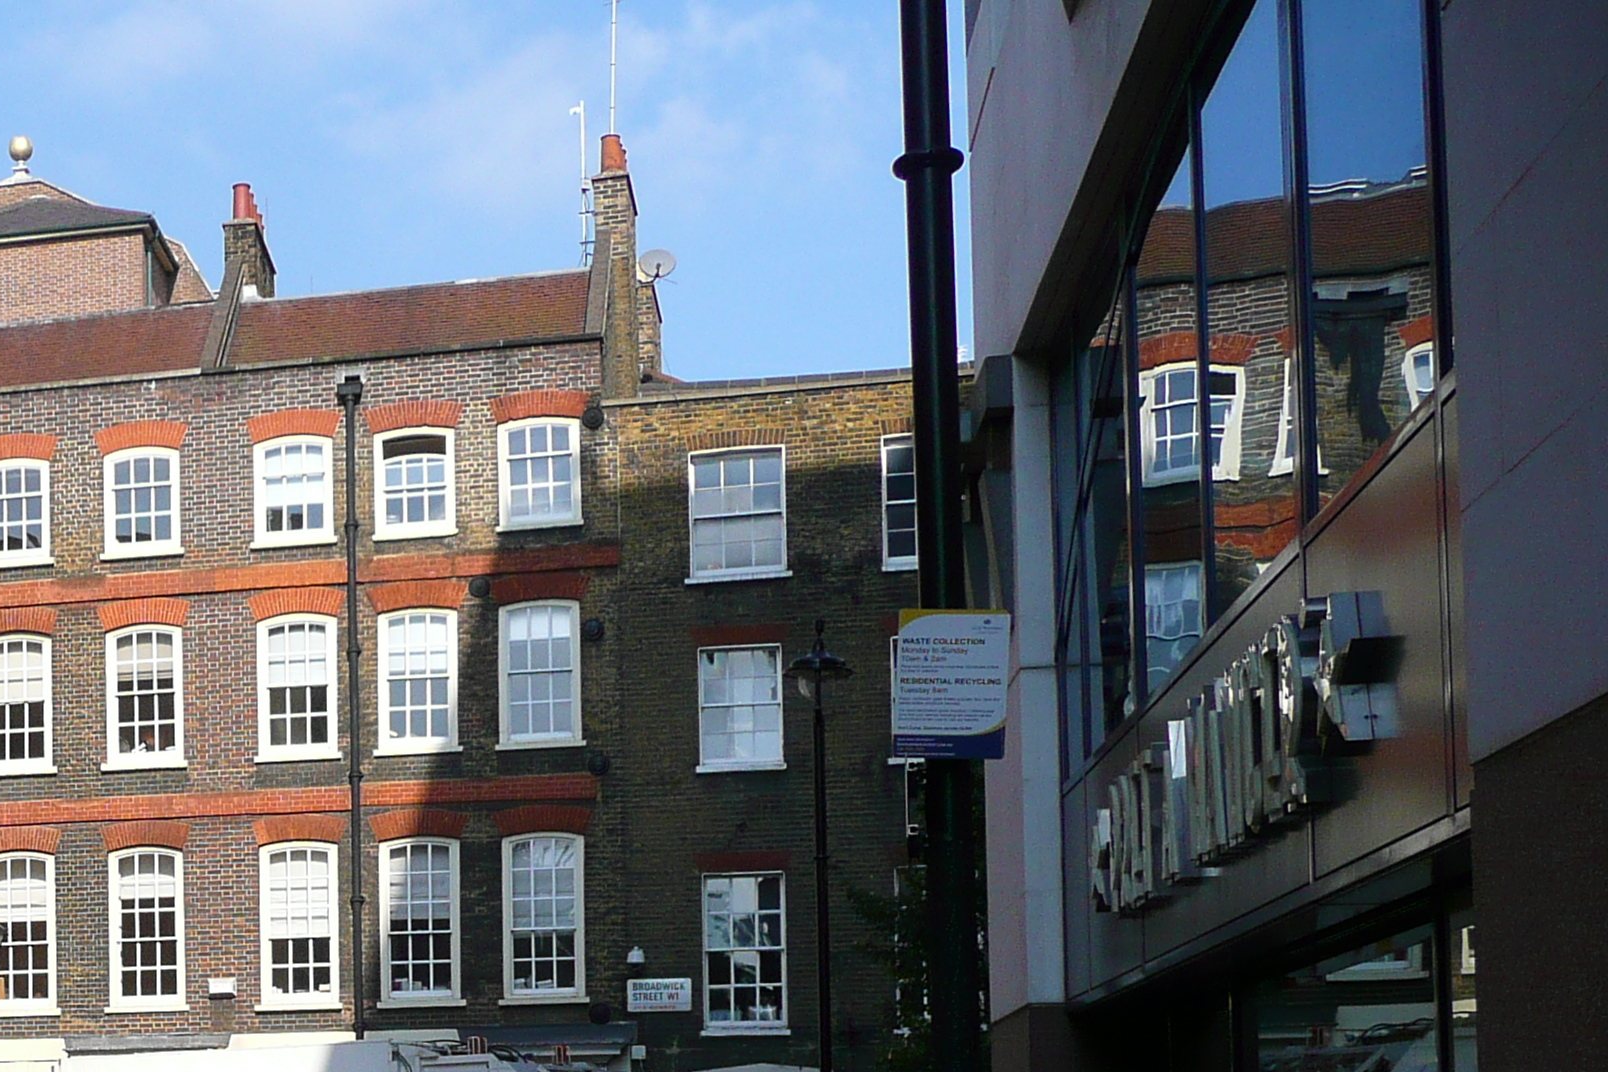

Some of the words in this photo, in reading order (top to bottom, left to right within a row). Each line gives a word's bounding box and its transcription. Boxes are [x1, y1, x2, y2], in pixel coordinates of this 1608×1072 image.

[902, 637, 930, 645] WASTE
[933, 637, 986, 645] COLLECTION
[901, 647, 929, 655] Monday
[942, 647, 968, 655] Sunday
[900, 677, 952, 685] RESIDENTIAL
[900, 686, 930, 695] Tuesday
[632, 982, 685, 991] BROADWICK
[632, 992, 663, 1001] STREET
[667, 992, 679, 1001] W1
